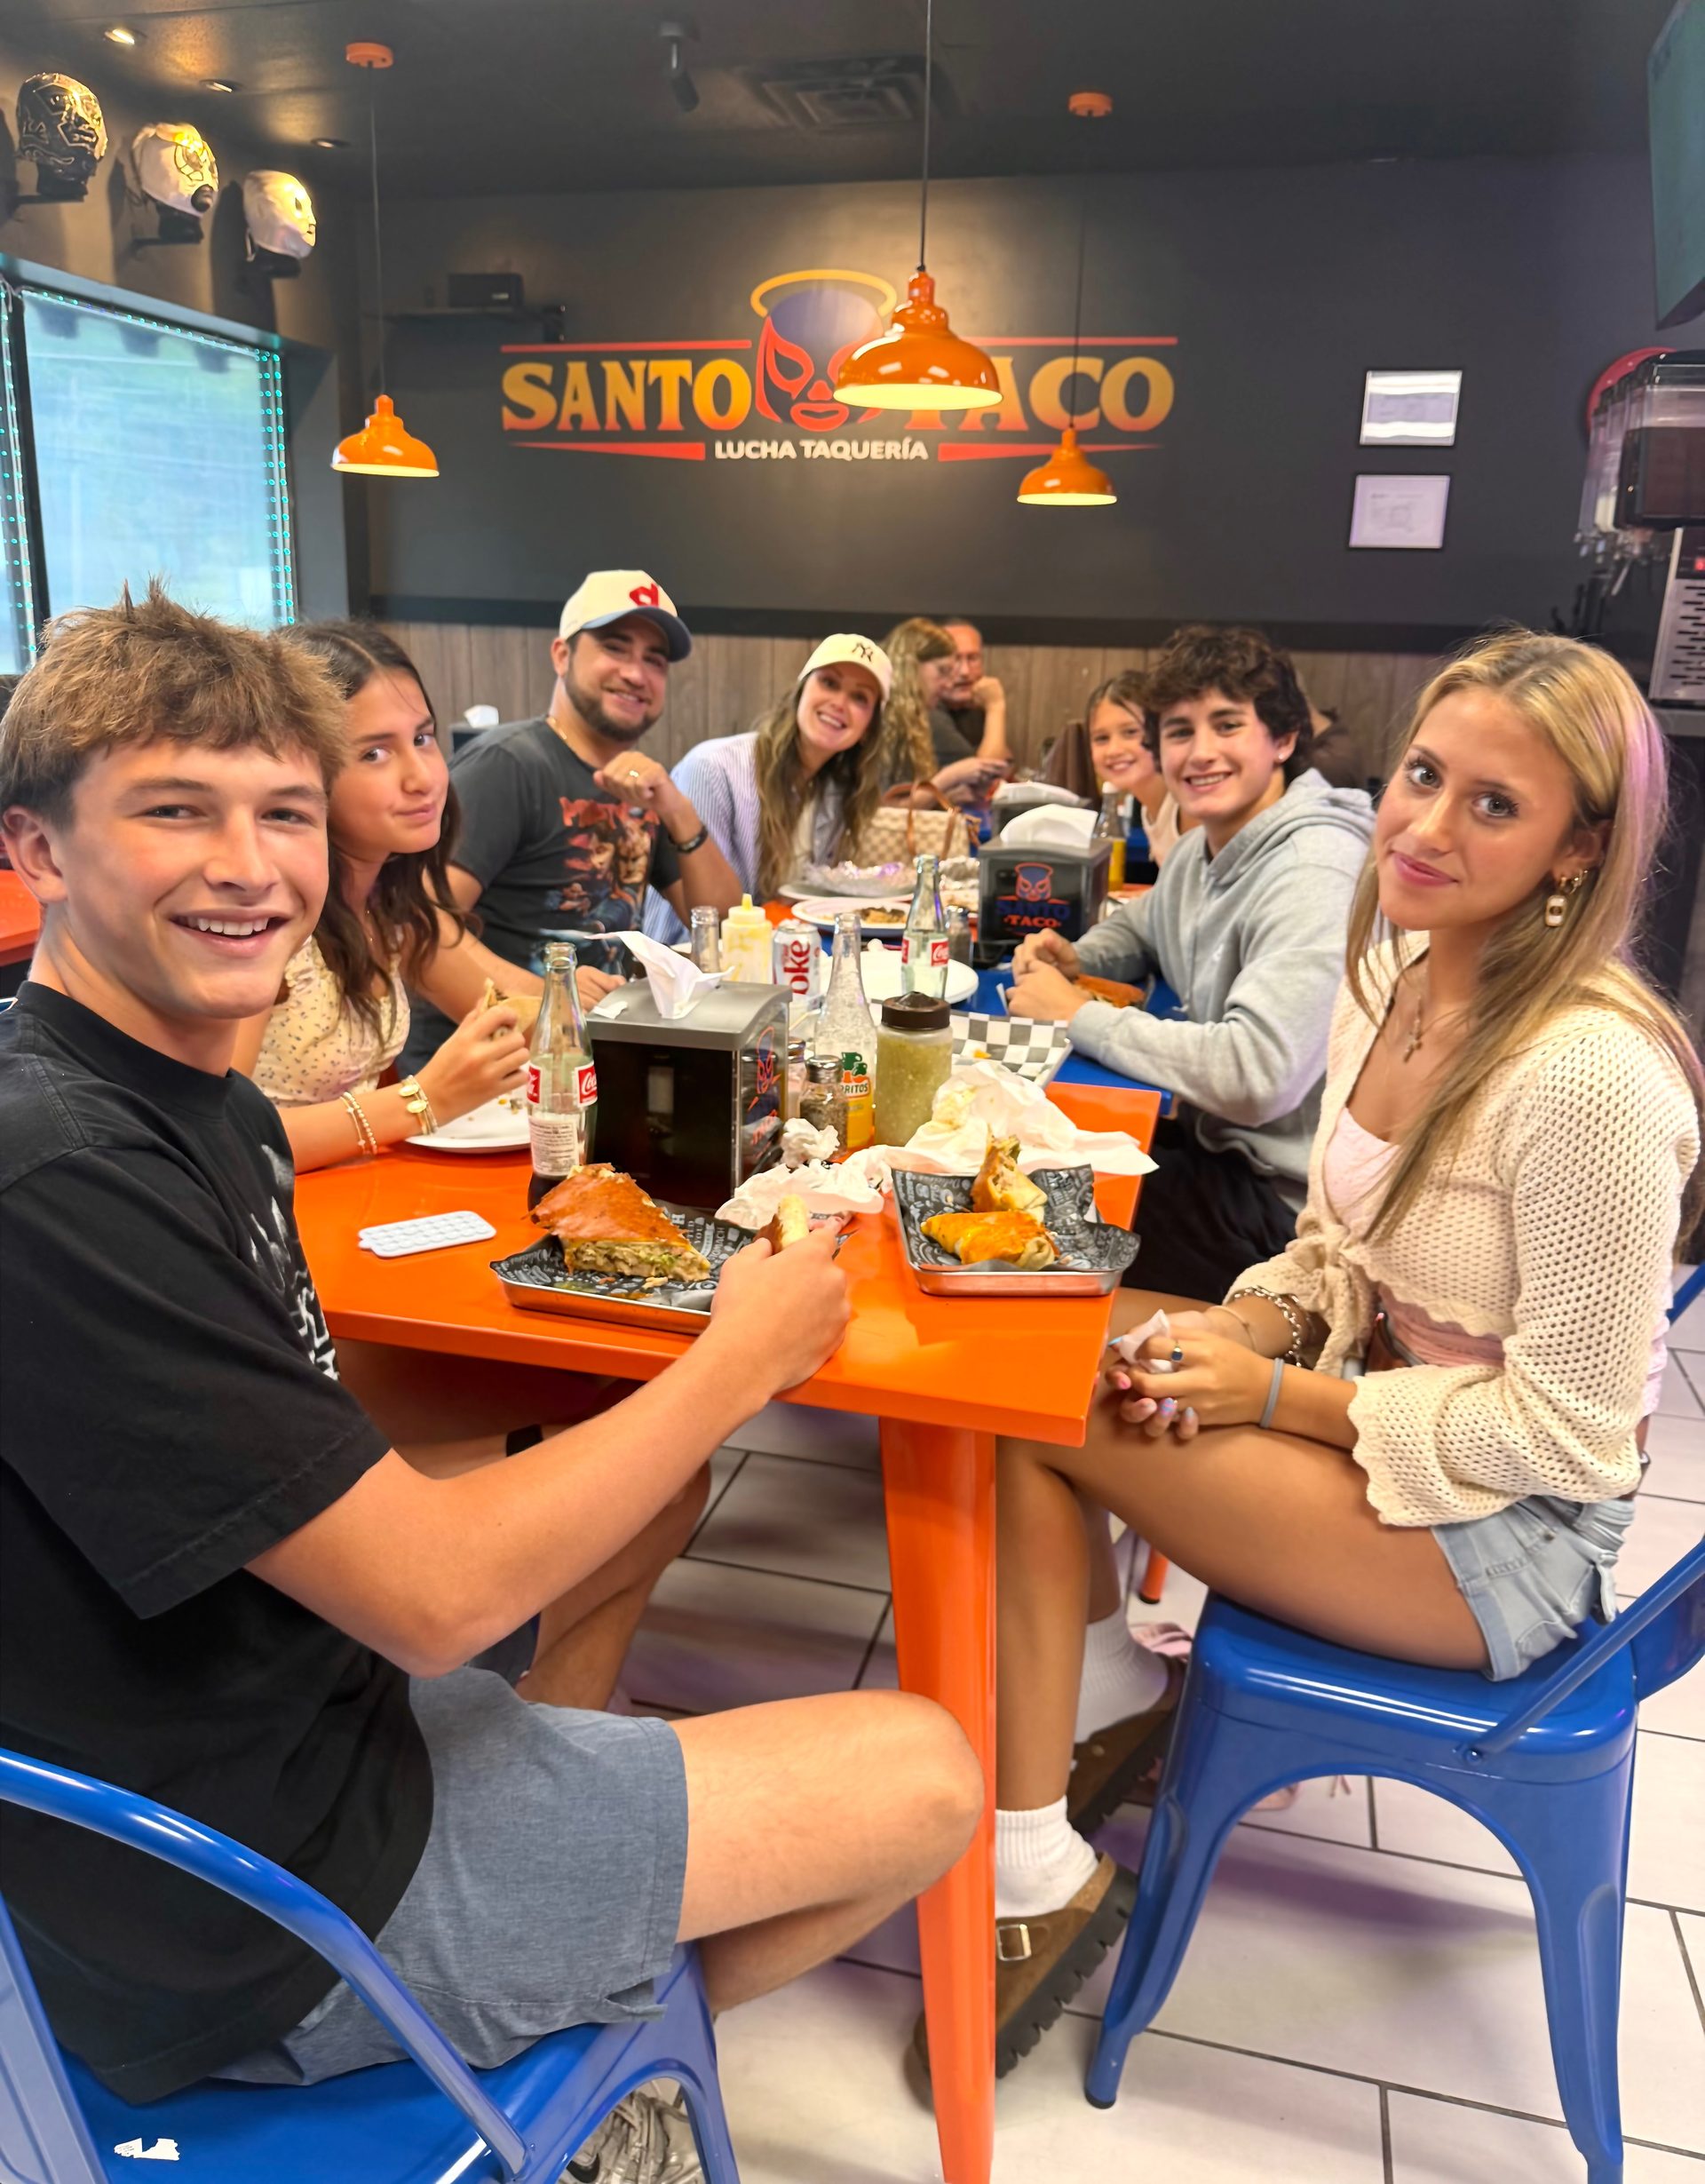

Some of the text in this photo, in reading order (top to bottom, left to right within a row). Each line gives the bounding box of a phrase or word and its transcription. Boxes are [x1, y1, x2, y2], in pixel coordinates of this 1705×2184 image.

[502, 359, 752, 431] SANTO
[715, 436, 929, 461] LUCHA TAQUERÍA
[995, 900, 1071, 920] SANTO
[783, 940, 810, 995] oke
